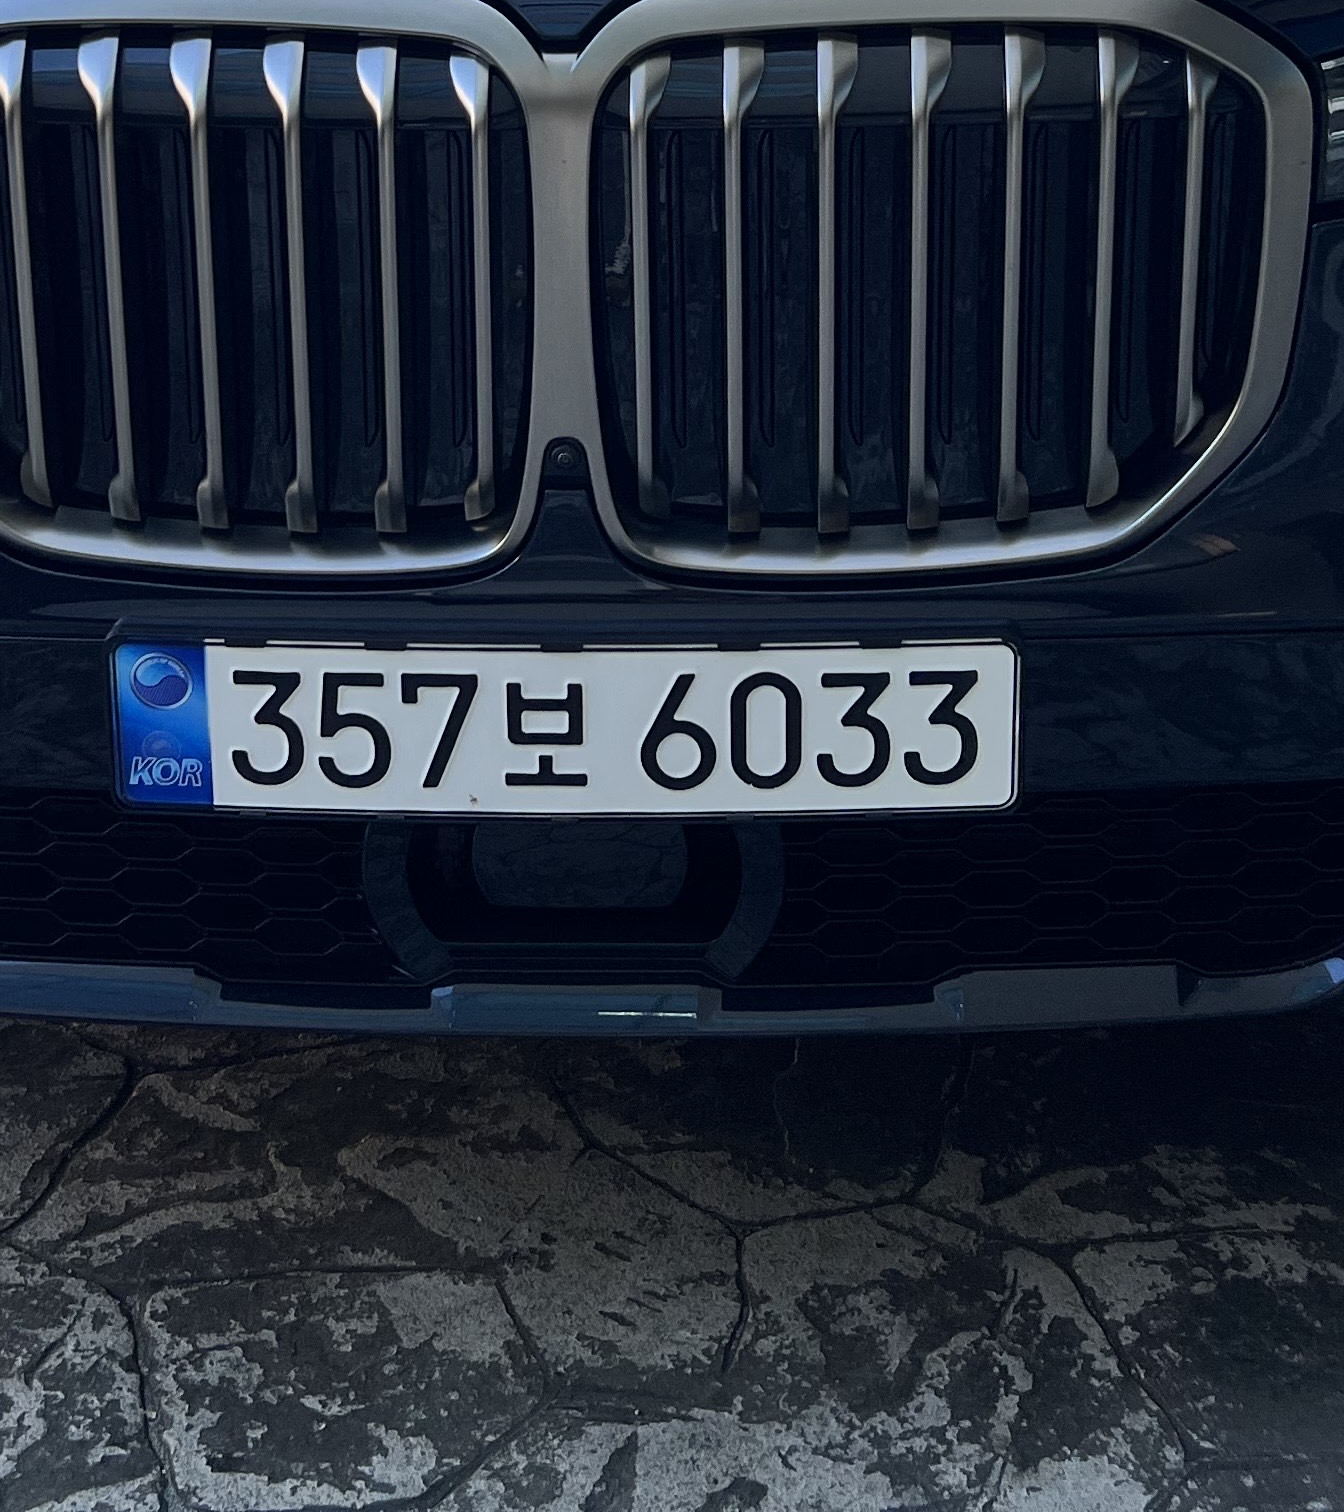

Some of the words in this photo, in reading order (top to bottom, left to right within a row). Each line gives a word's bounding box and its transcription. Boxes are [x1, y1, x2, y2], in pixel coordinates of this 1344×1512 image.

[232, 670, 587, 788] 357보
[641, 670, 978, 790] 6033
[129, 756, 203, 787] KOR
